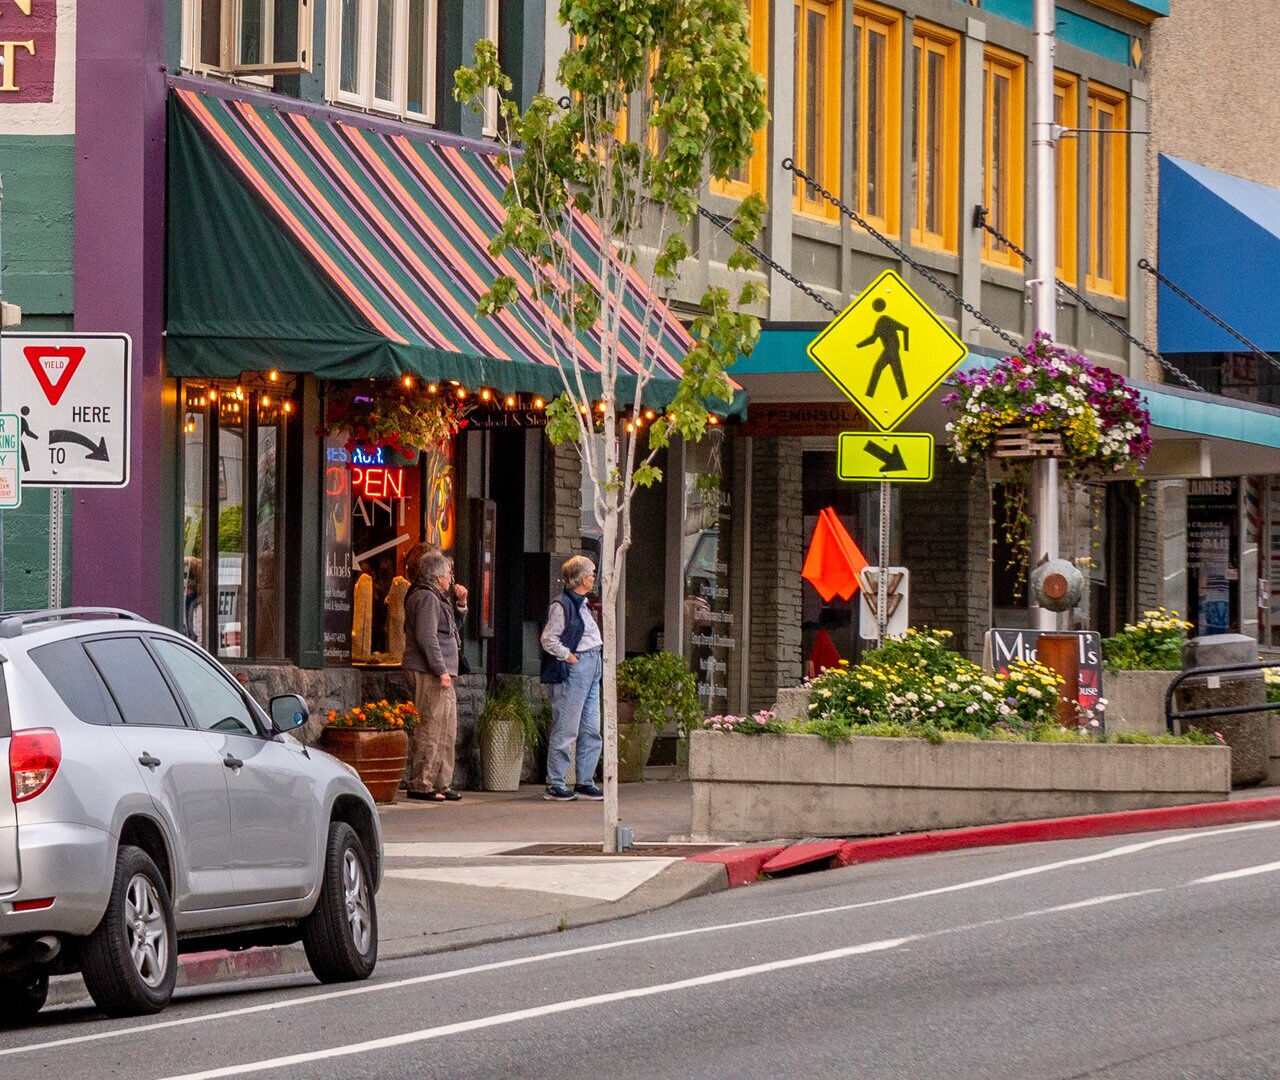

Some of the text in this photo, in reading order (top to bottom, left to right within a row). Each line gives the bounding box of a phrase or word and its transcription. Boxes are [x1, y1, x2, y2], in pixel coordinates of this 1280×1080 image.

[44, 360, 64, 369] YIELD
[72, 406, 111, 423] HERE
[470, 414, 508, 427] Seafood
[48, 447, 66, 464] TO
[326, 466, 403, 498] OPEN
[1186, 480, 1233, 495] LANNERS
[994, 631, 1098, 665] Micl's
